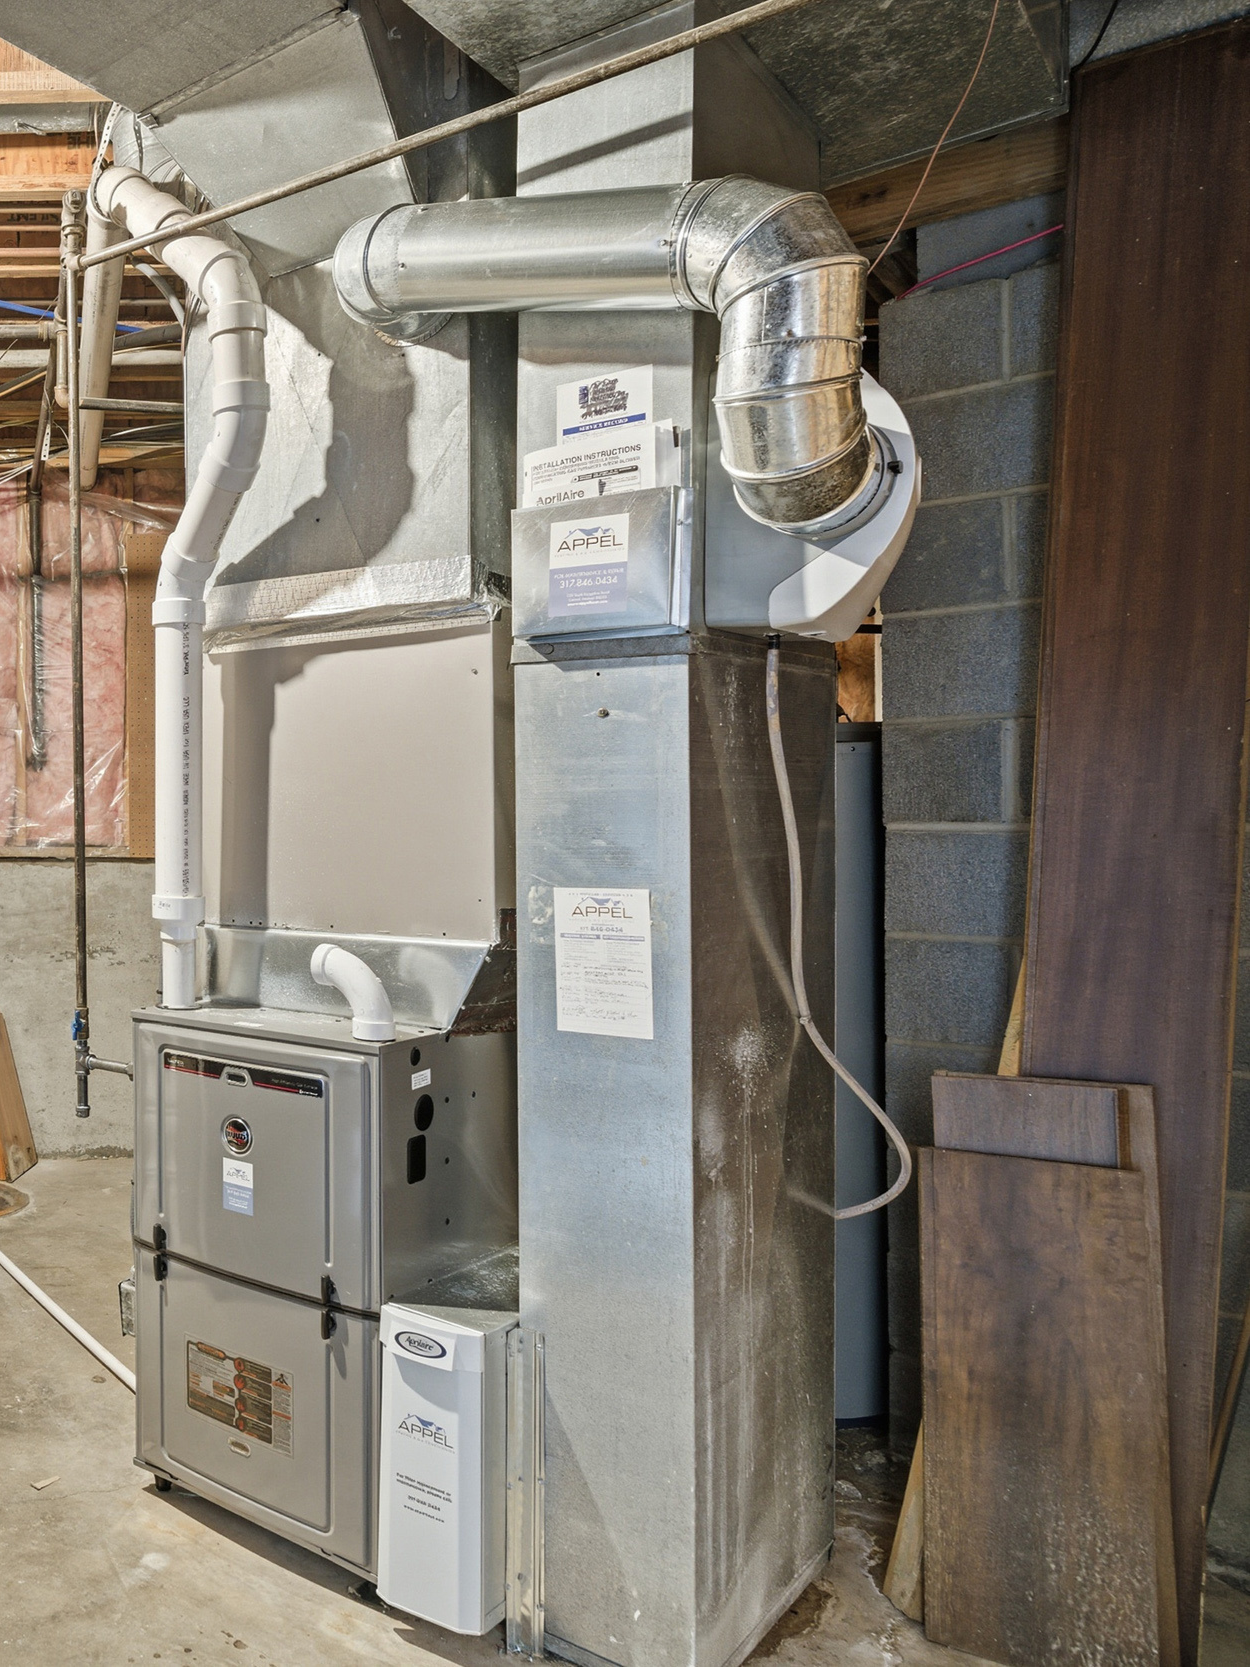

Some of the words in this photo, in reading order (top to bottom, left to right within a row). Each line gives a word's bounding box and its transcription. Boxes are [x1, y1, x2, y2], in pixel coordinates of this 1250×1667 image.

[533, 455, 583, 471] INSTALLATION
[584, 443, 642, 461] INSTRUCTIONS
[557, 534, 624, 552] APPEL
[571, 905, 633, 918] APPEL
[398, 1420, 454, 1449] APPEL
